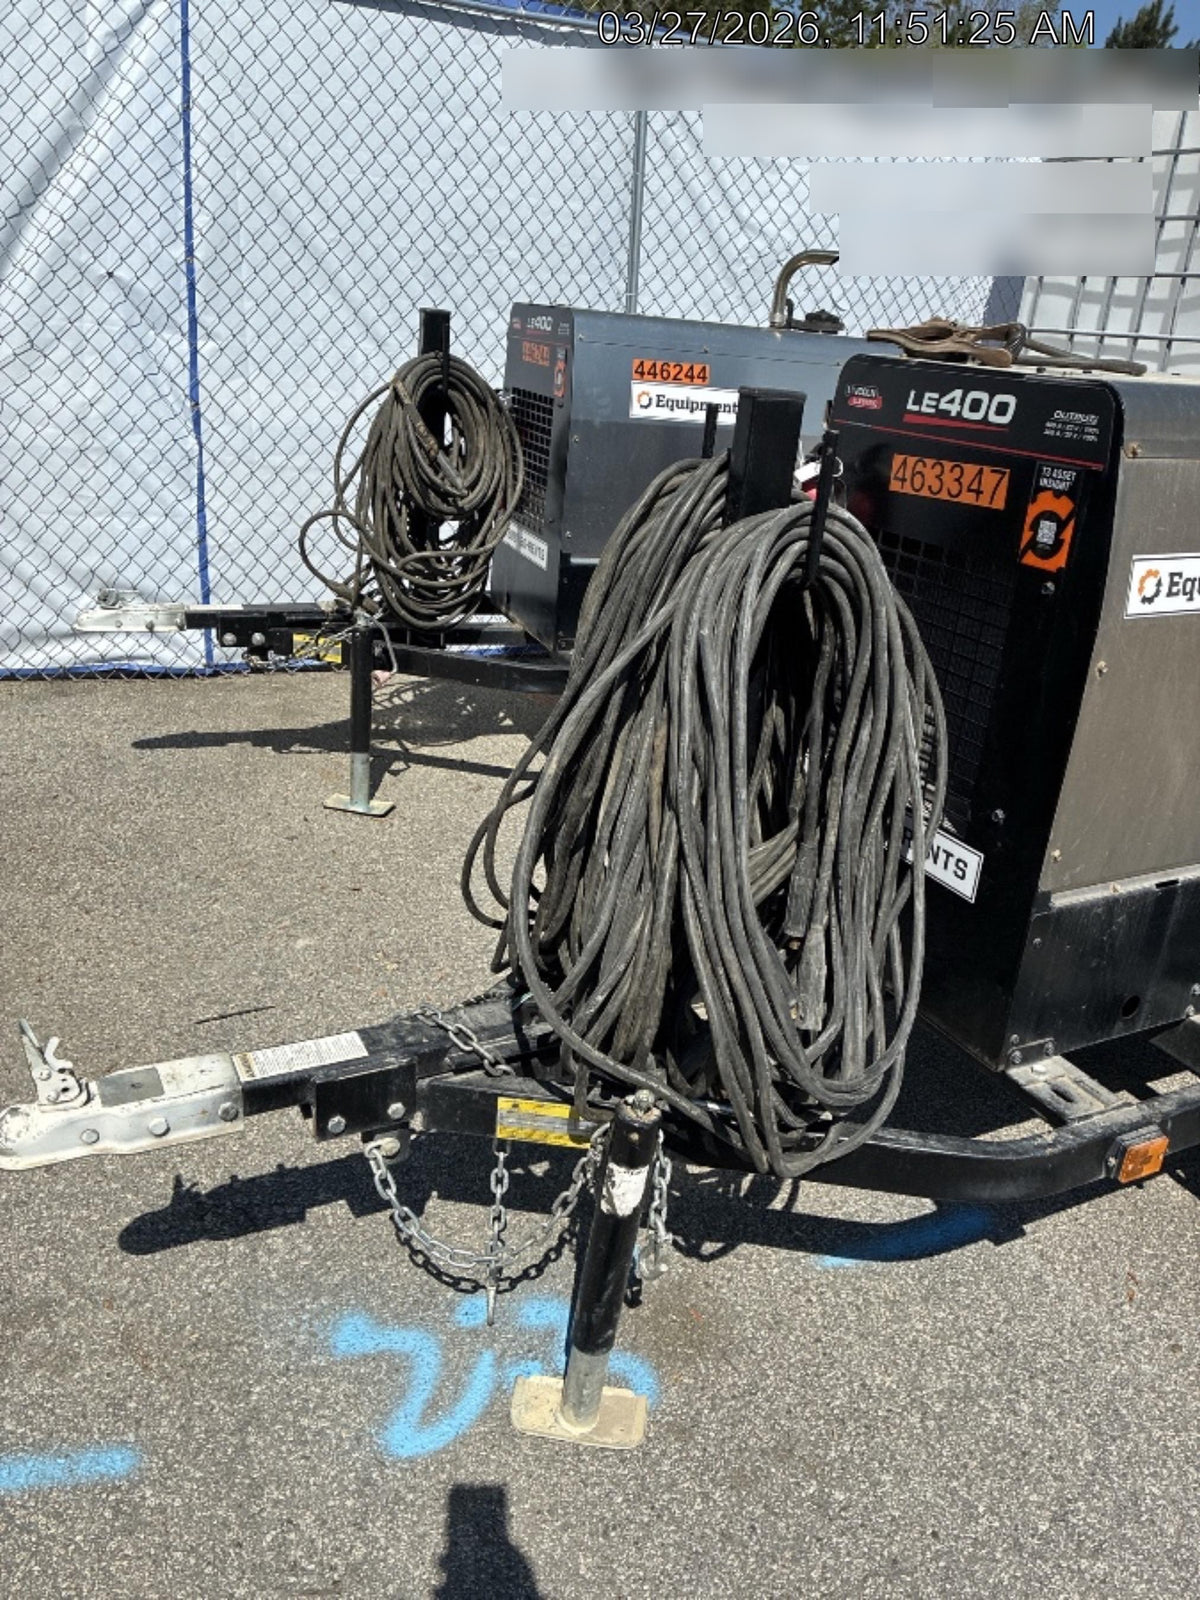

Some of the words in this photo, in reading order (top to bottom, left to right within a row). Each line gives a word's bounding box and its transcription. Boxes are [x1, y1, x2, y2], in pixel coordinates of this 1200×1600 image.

[634, 360, 708, 382] 446244
[905, 388, 1018, 424] LE400
[892, 455, 1008, 505] 463347
[927, 843, 968, 881] NTS
